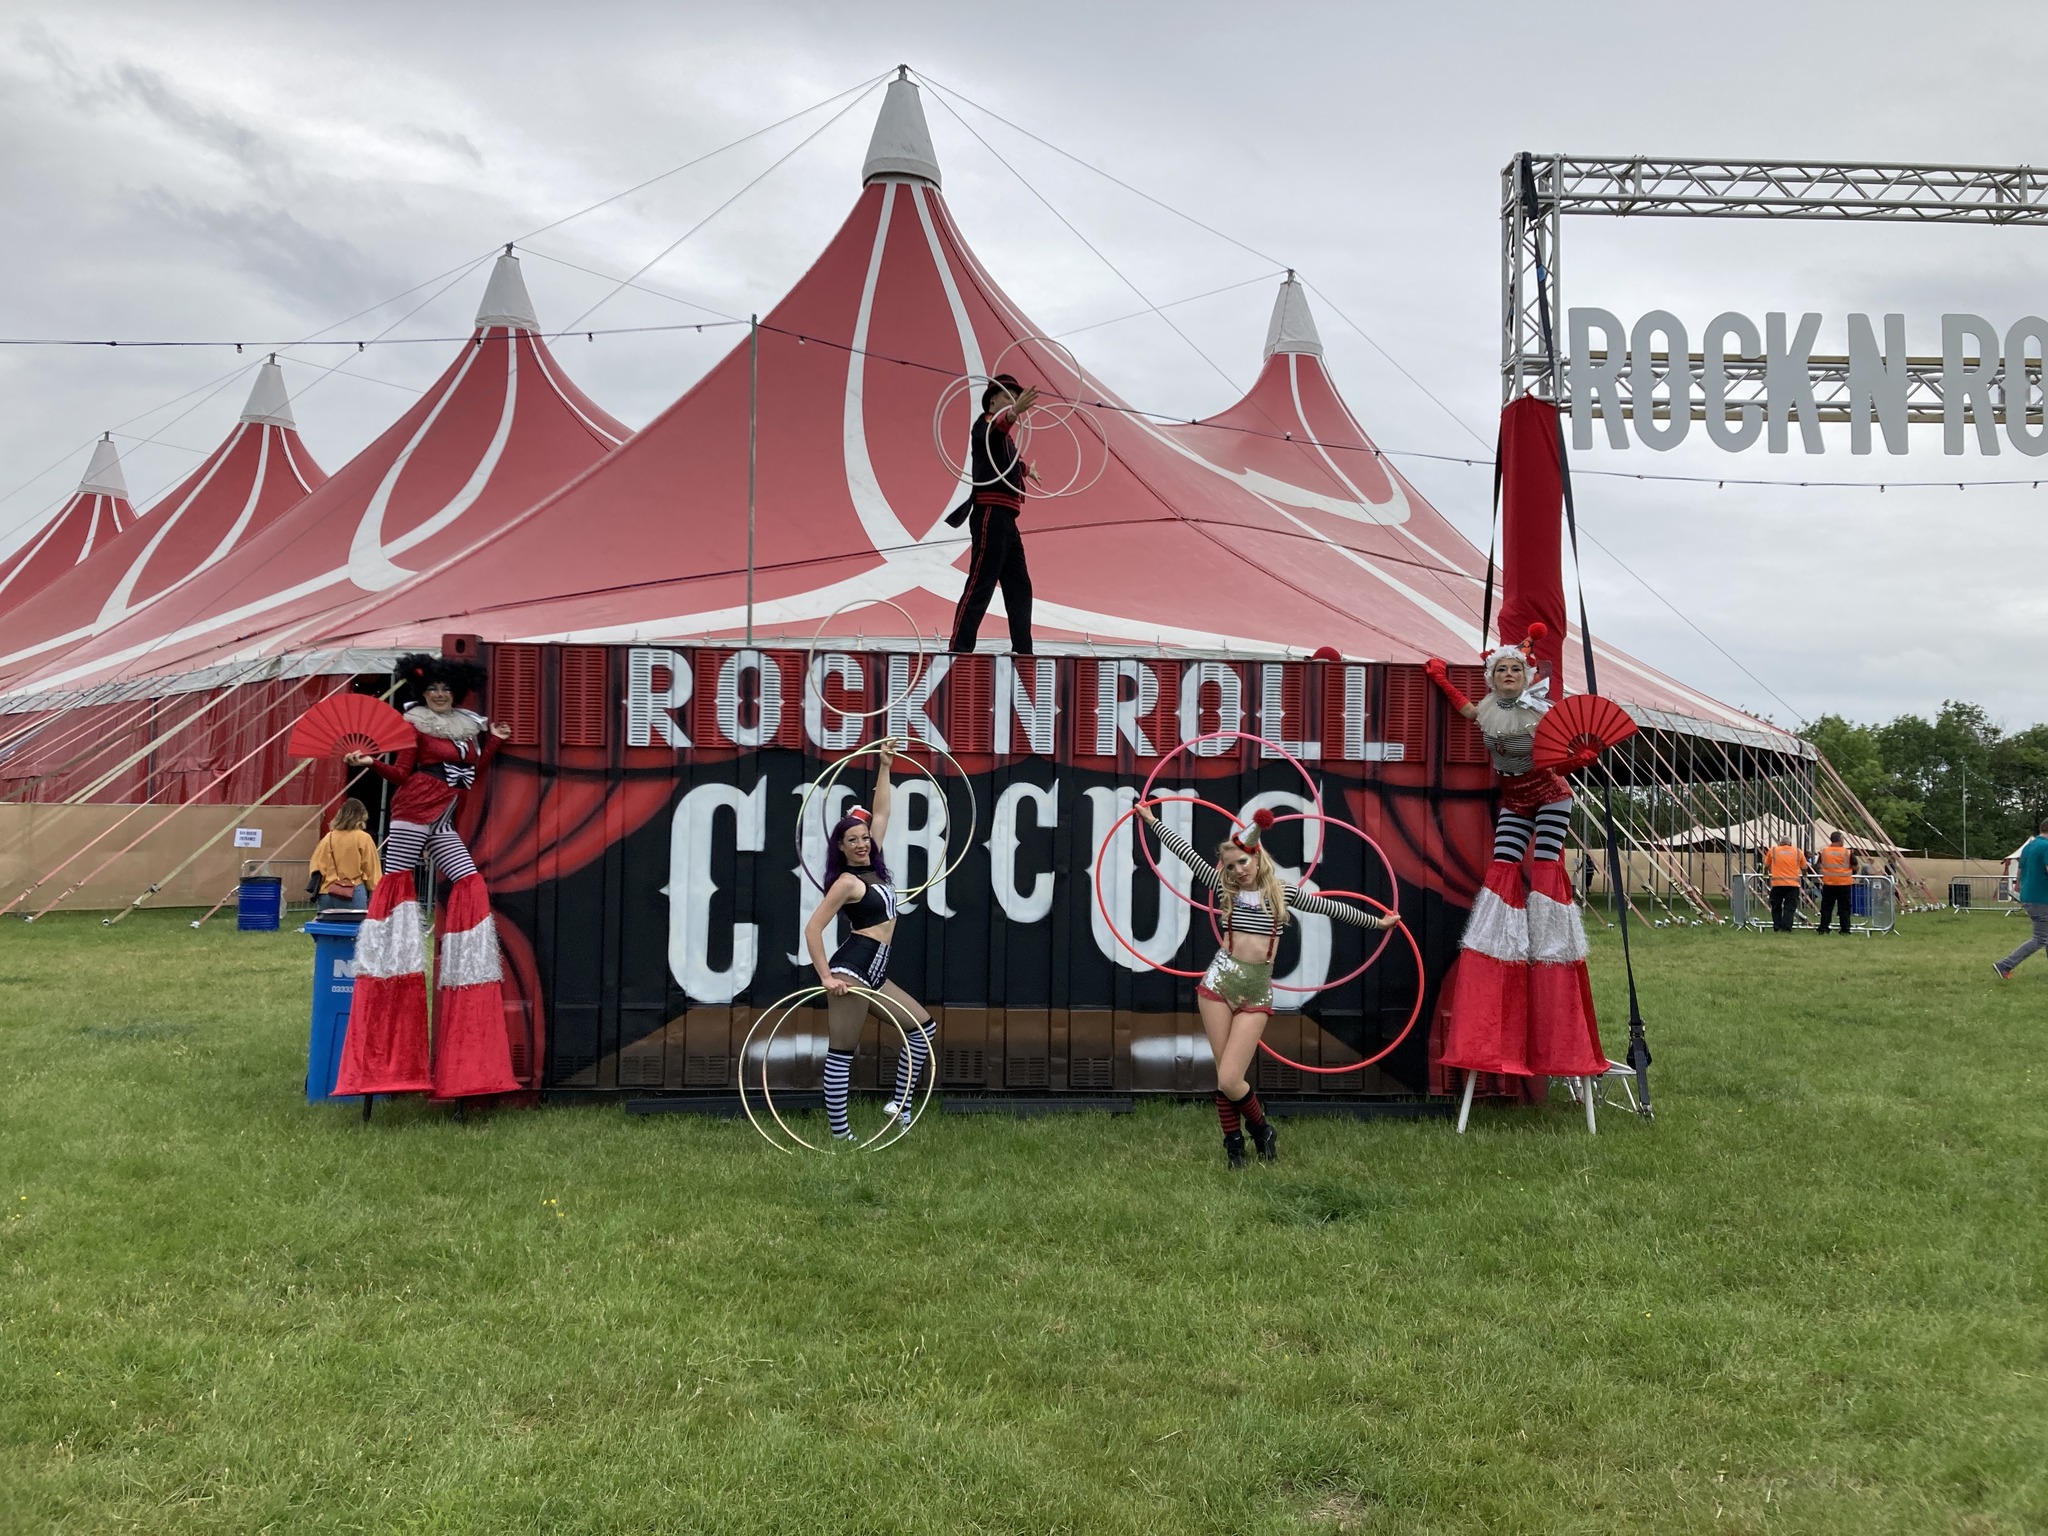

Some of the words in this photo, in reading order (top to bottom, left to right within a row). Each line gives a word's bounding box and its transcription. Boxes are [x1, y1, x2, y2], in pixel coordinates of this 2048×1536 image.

[1566, 307, 1826, 454] ROCK
[1846, 312, 1911, 455] N
[622, 648, 957, 754] ROCK
[990, 655, 1061, 755] N
[1094, 659, 1405, 761] ROLL
